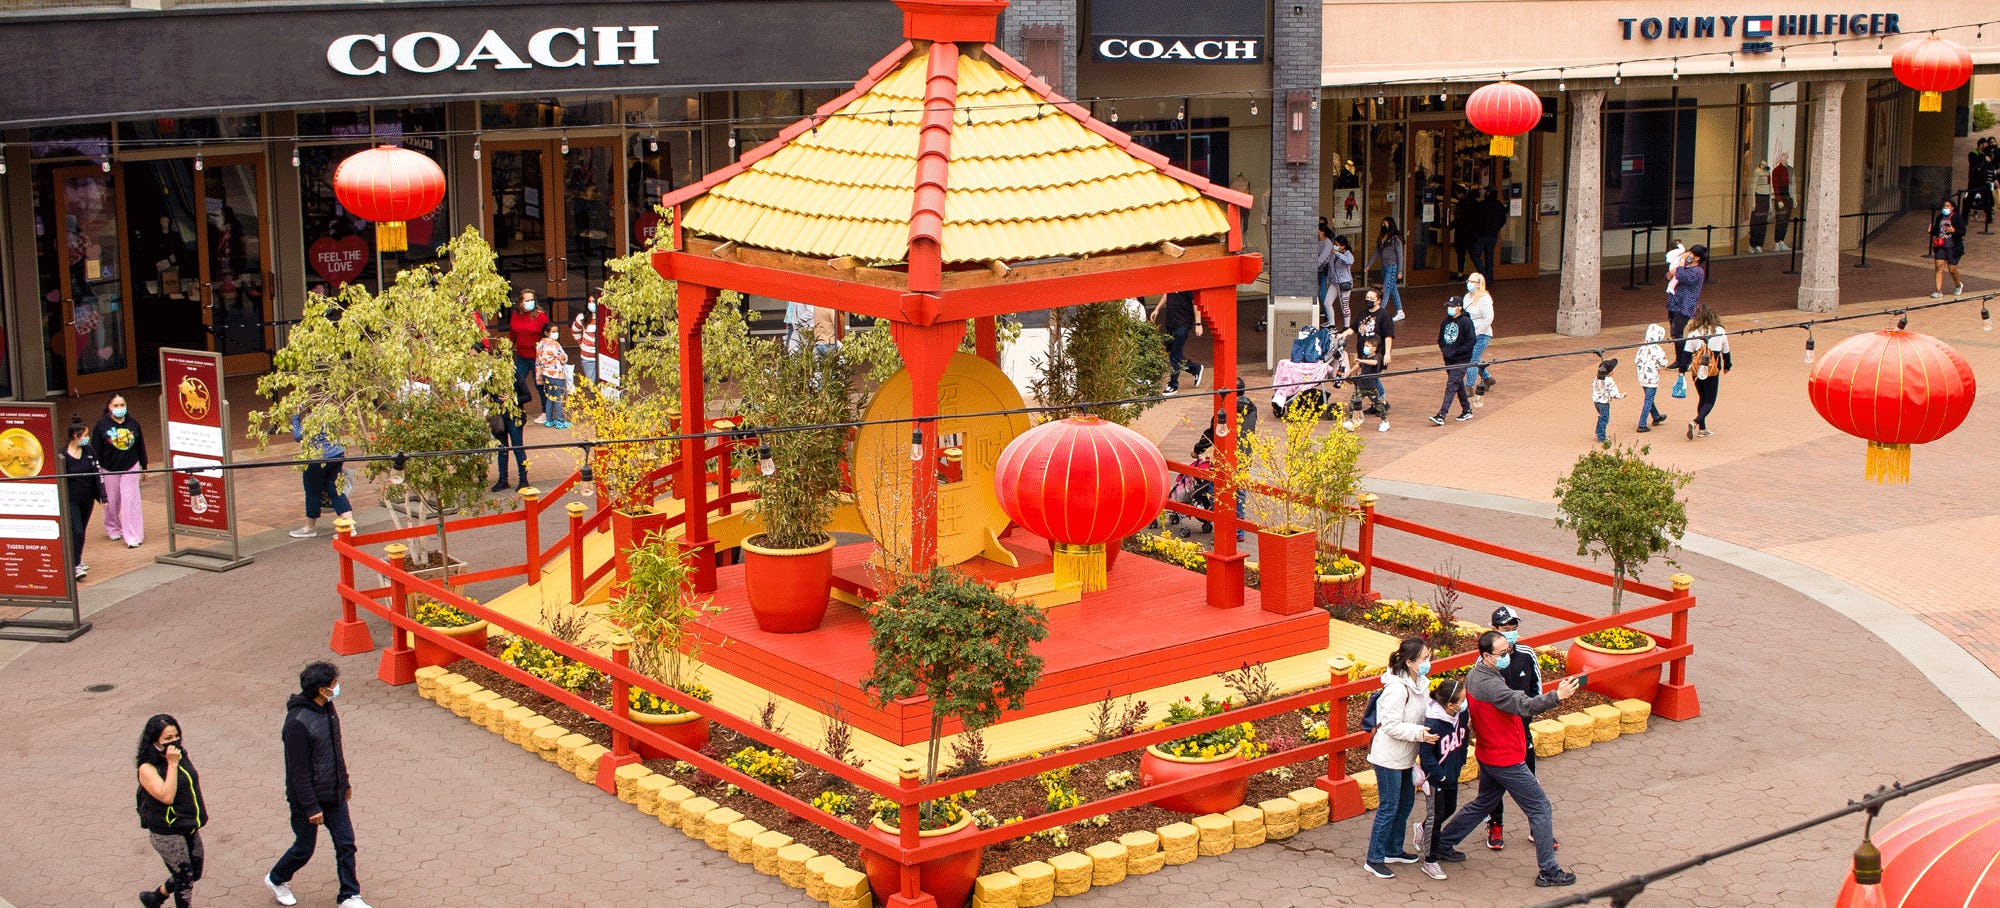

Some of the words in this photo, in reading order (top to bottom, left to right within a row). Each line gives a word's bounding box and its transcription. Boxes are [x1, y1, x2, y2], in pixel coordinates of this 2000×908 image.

[1618, 15, 1738, 41] TOMMY
[1778, 13, 1901, 36] HILFIGER
[327, 25, 660, 76] COACH
[1099, 37, 1258, 61] COACH
[318, 251, 342, 263] FEEL
[342, 249, 361, 261] THE
[327, 261, 353, 273] LOVE
[1440, 727, 1465, 755] GAP
